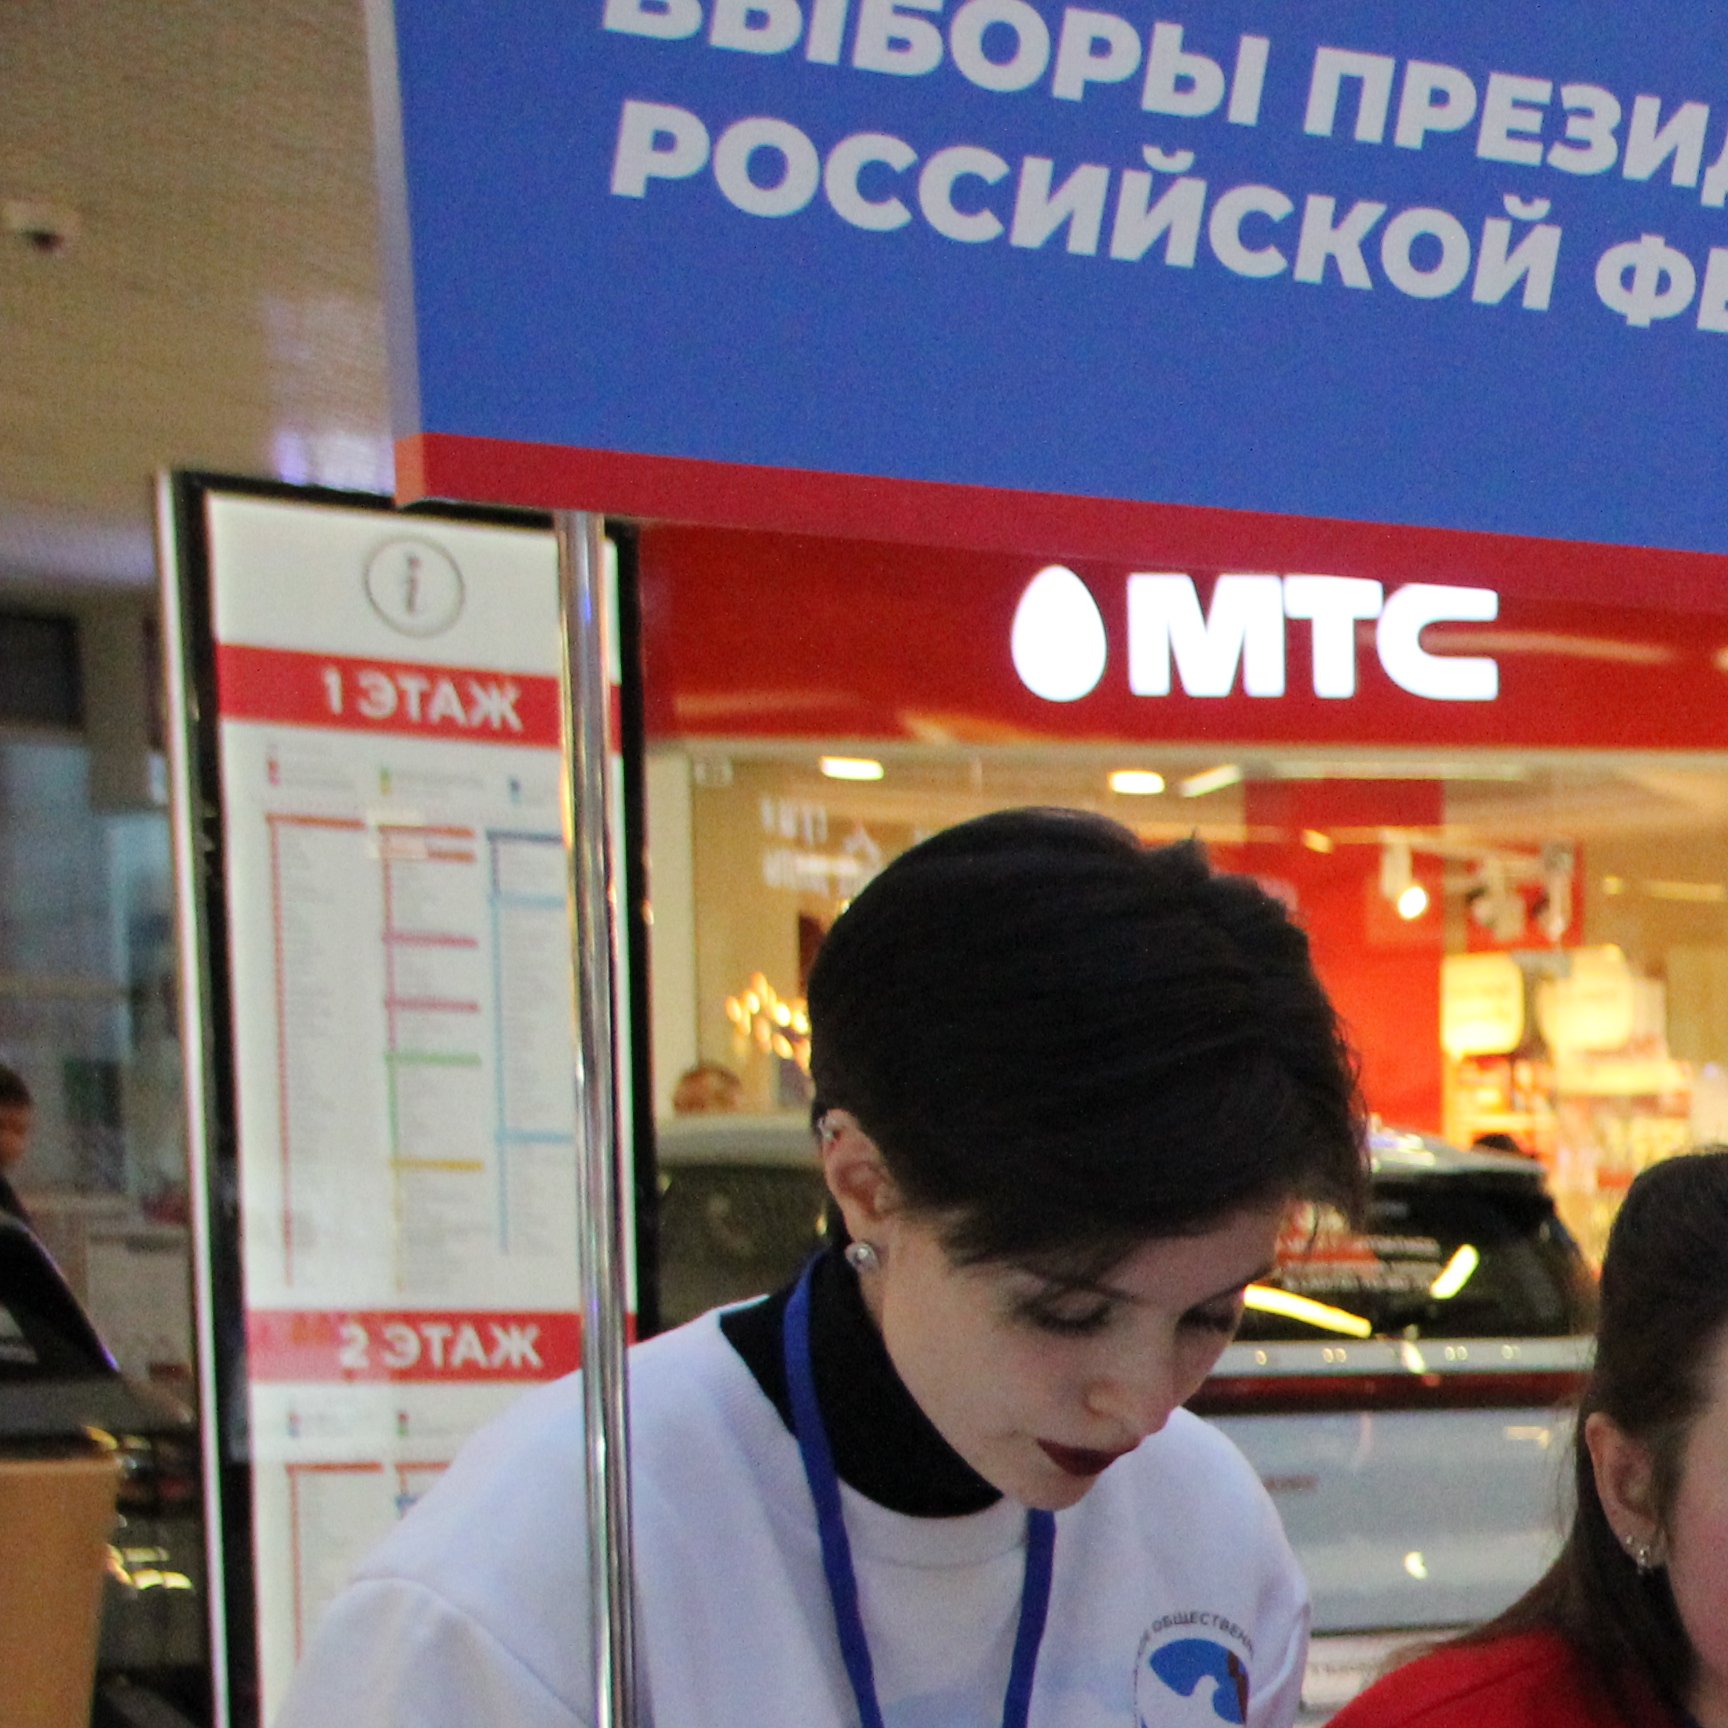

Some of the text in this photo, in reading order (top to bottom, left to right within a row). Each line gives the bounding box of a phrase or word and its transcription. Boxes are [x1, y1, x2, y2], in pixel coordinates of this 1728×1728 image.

[610, 99, 1563, 312] РОССИЙСКОЙ
[1126, 572, 1500, 702] МТС
[354, 668, 525, 733] ЭТАЖ
[338, 1324, 545, 1371] 2 ЭТАЖ
